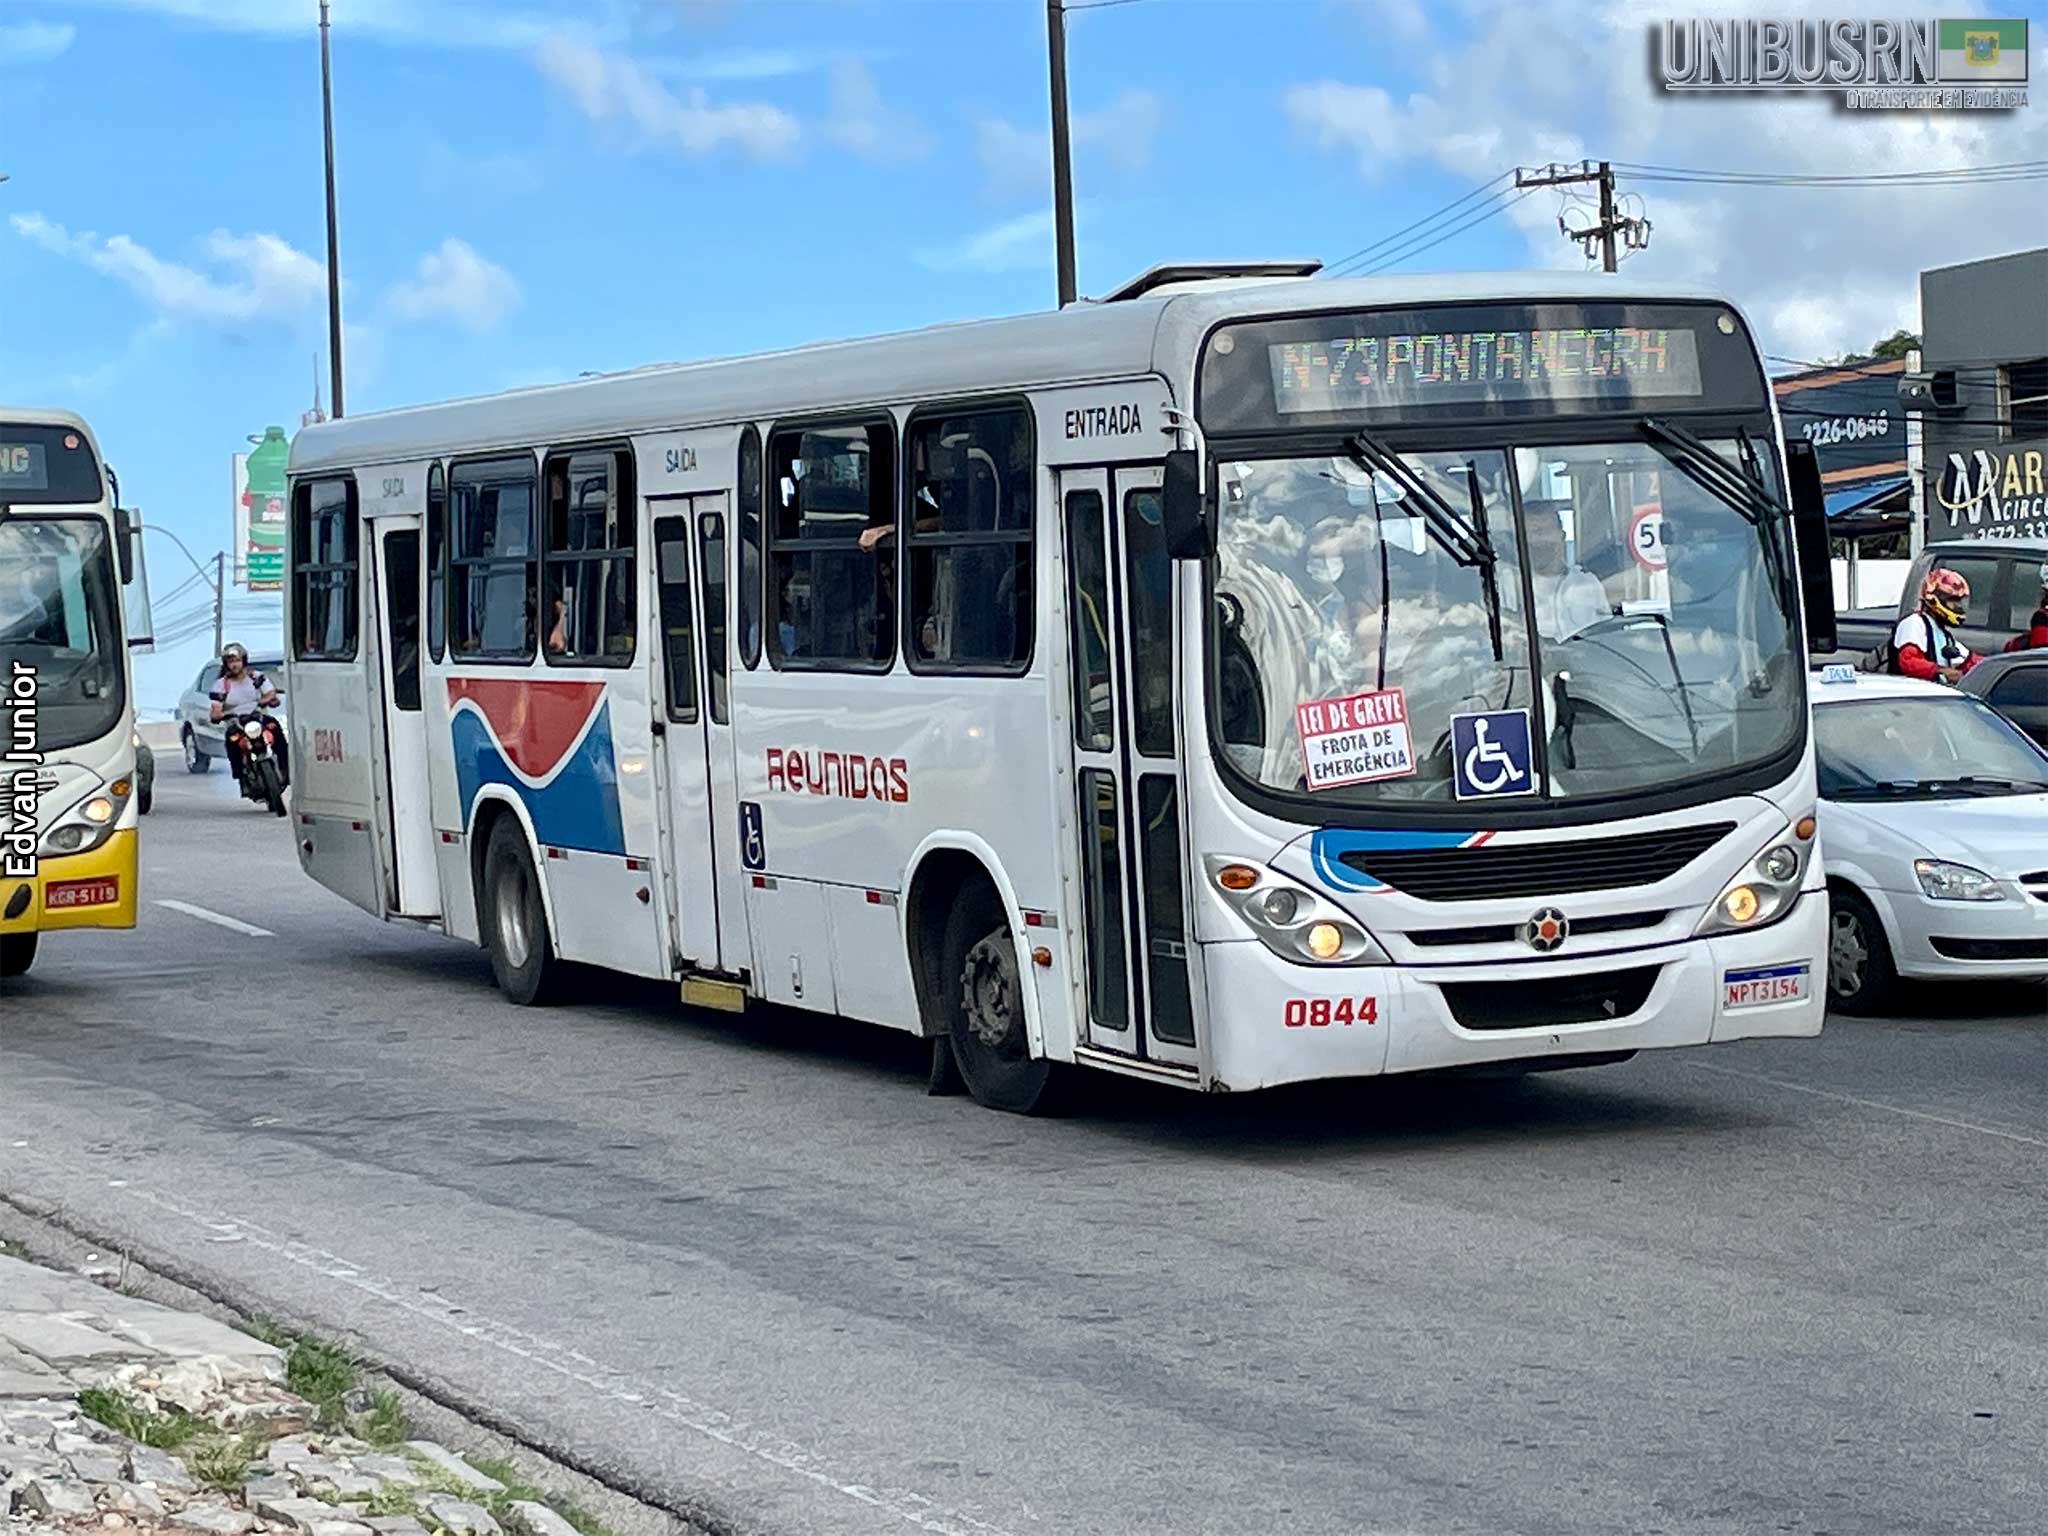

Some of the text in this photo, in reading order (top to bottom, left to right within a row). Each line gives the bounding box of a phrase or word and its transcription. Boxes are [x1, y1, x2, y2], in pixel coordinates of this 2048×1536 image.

[1386, 331, 1522, 384] PONTA
[1065, 403, 1142, 439] ENTRADA
[1300, 693, 1403, 735] LEI DE GREVE
[1321, 729, 1393, 756] FROTA DE
[1313, 751, 1408, 780] EMERGÊNCIA
[1729, 978, 1798, 1003] NPT3154
[1285, 997, 1378, 1027] 0844
